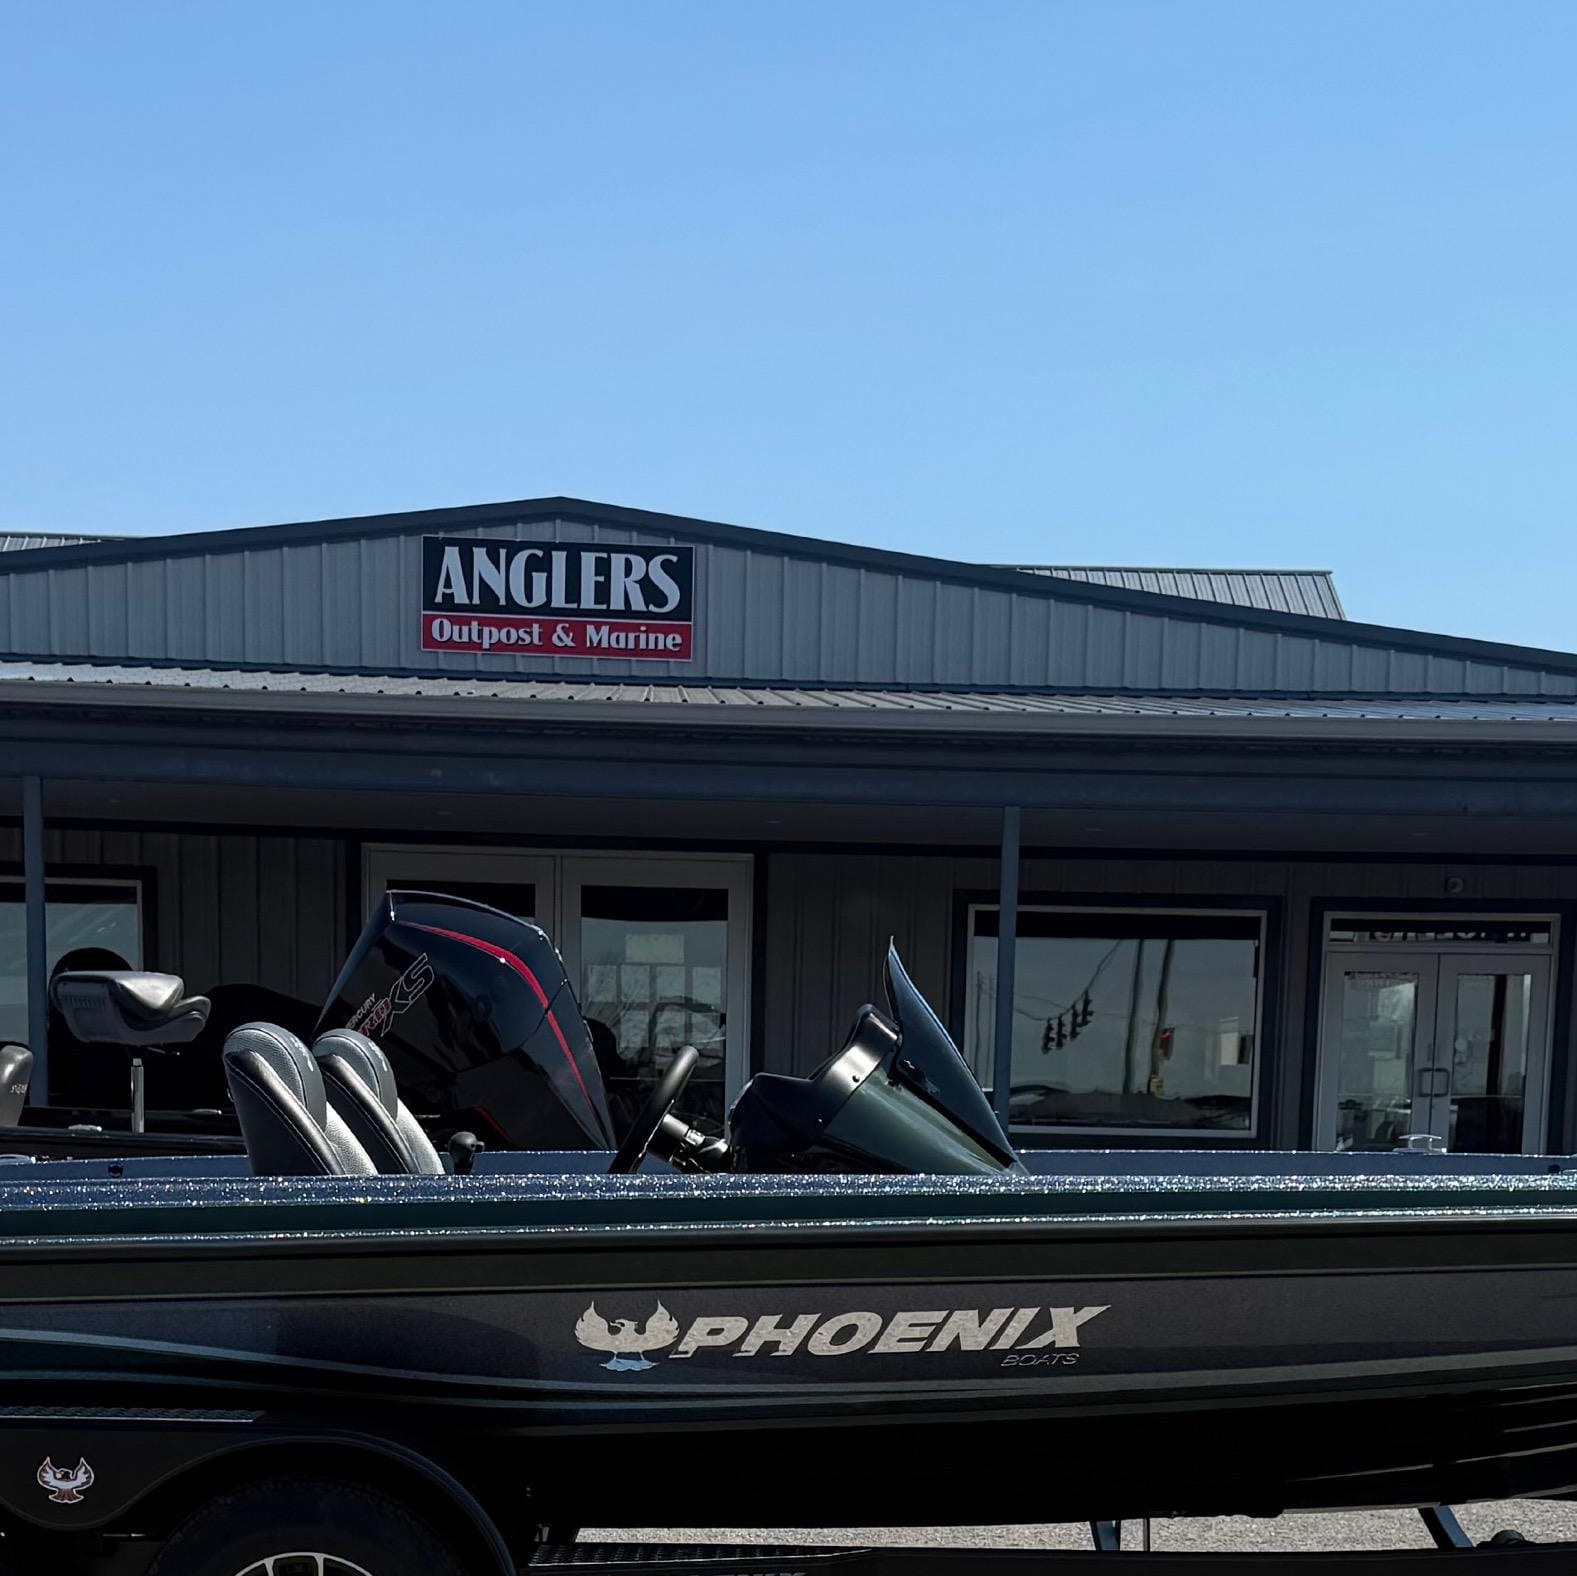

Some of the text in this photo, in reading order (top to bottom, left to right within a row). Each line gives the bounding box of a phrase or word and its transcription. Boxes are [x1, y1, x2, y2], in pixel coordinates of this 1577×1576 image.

[434, 545, 681, 614] ANGLERS
[431, 618, 683, 652] Outpost & Marine
[344, 992, 376, 1029] ERCURY
[668, 1304, 1112, 1360] PHOENIX
[1001, 1353, 1080, 1368] BOATS
